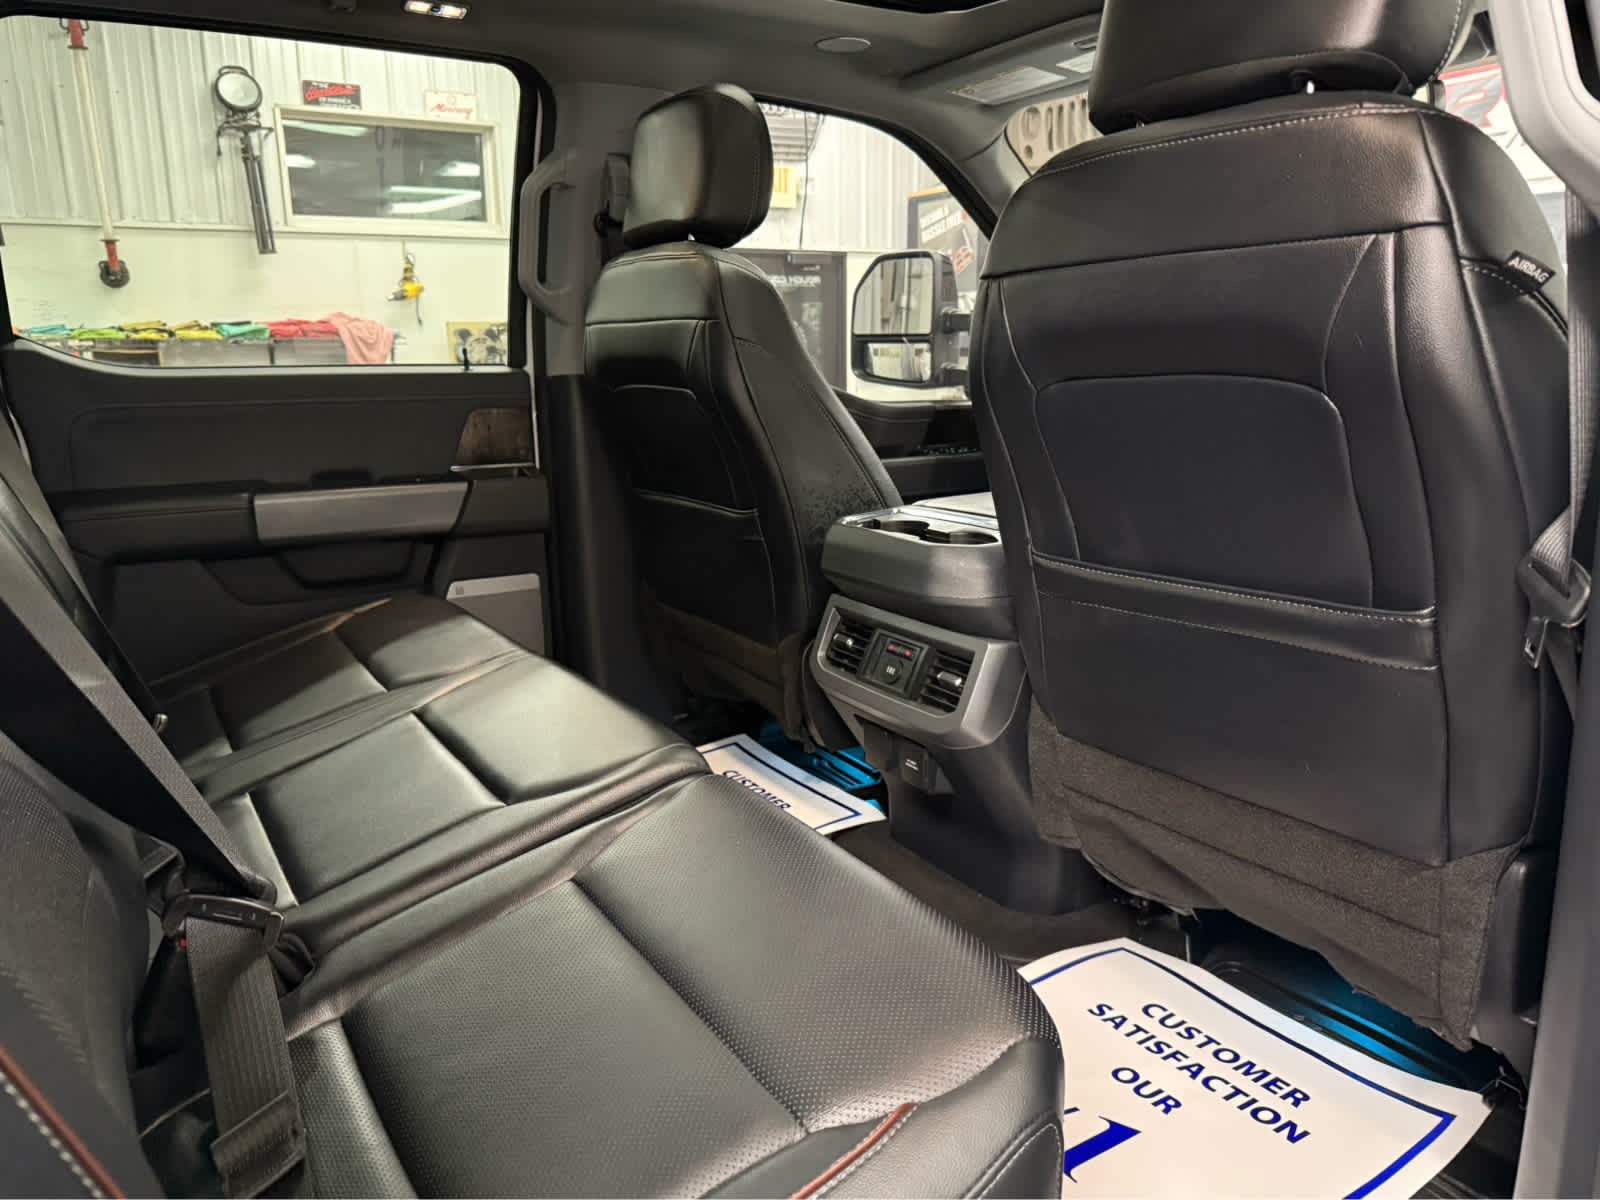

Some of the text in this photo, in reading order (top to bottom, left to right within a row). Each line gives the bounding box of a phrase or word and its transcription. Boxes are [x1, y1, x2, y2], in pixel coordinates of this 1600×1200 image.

[1508, 256, 1549, 283] AIRBAG
[1087, 1003, 1311, 1144] SATISFACTION
[1111, 1067, 1183, 1115] OUR
[1141, 1003, 1311, 1108] CUSTOMER
[1064, 1107, 1142, 1183] 1
